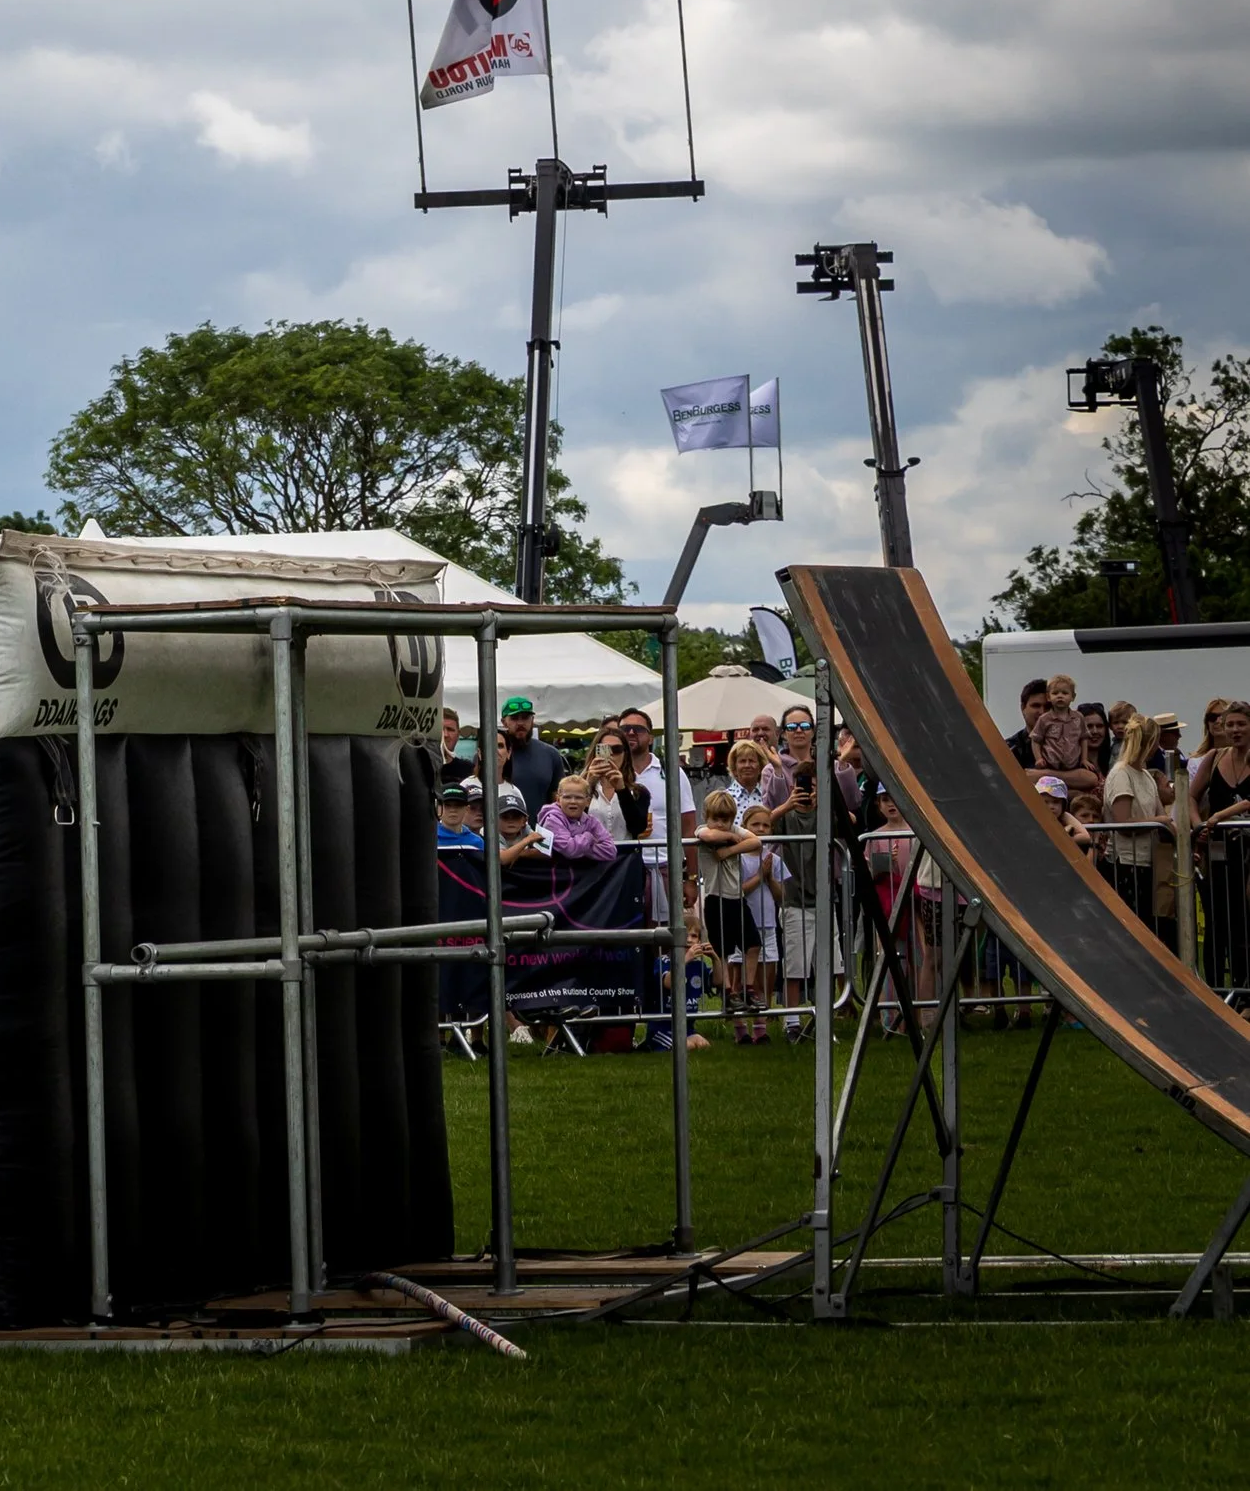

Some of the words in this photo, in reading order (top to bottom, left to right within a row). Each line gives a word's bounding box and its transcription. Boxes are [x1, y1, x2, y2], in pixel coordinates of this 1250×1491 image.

[519, 952, 549, 966] new
[506, 991, 537, 1001] Sponsors
[539, 989, 549, 998] of
[548, 988, 561, 997] the
[562, 987, 587, 996] Rutland
[588, 987, 616, 998] County
[617, 987, 635, 996] Show
